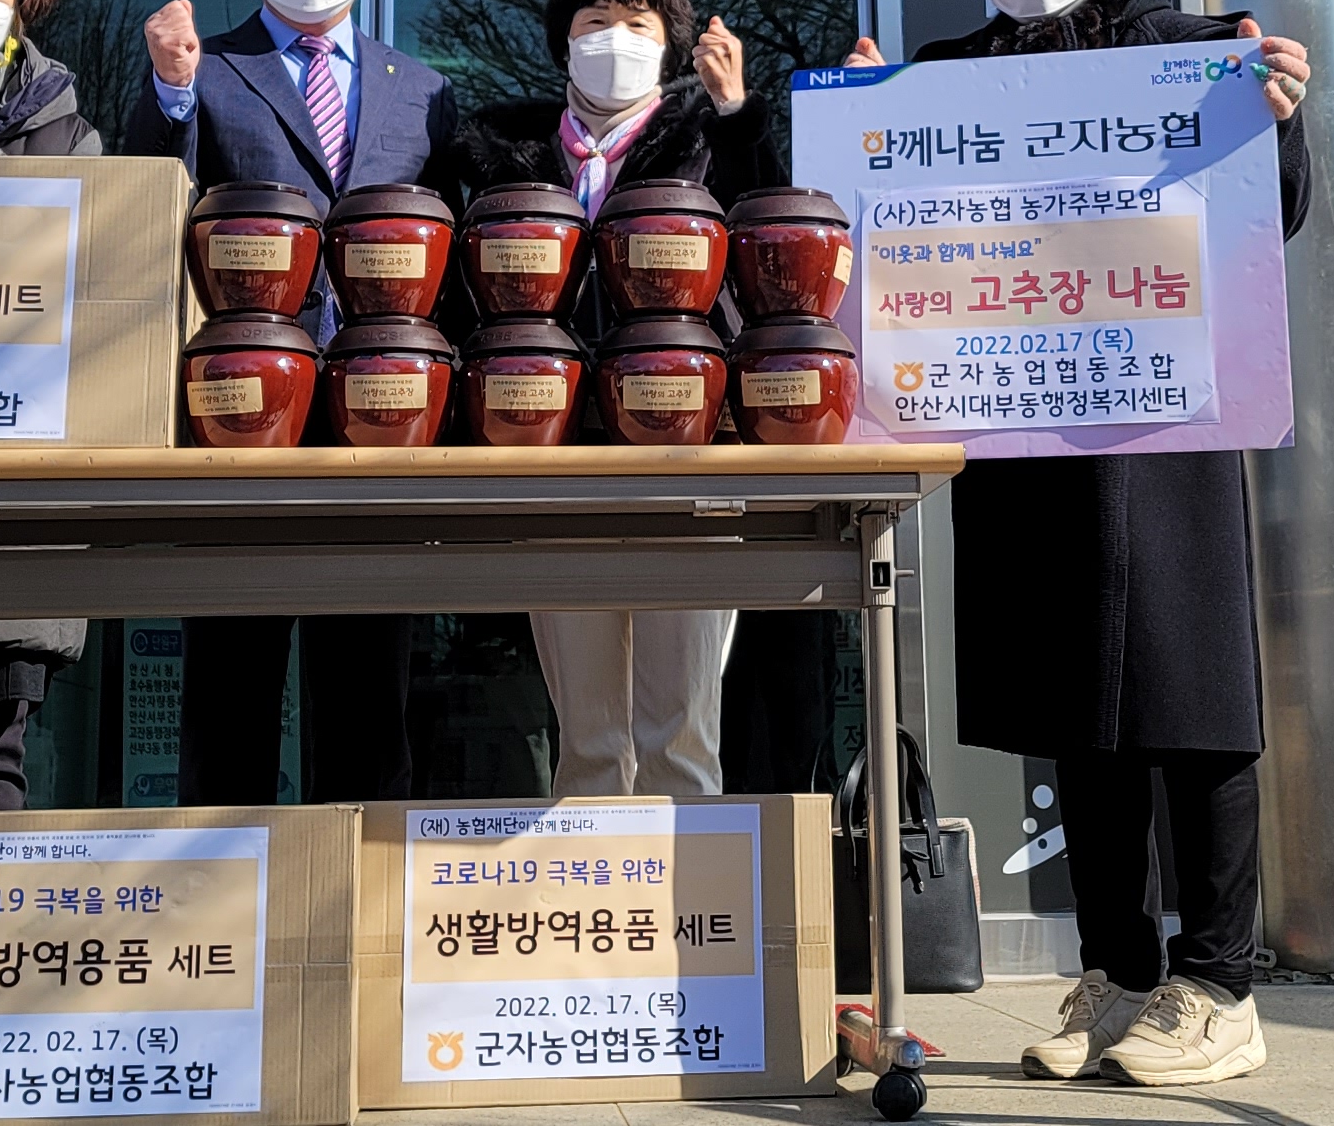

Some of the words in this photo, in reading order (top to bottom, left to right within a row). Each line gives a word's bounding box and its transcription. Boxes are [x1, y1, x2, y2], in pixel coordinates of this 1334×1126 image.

[1162, 58, 1202, 72] 함께하는
[809, 70, 845, 86] NH
[1023, 110, 1202, 158] 군자농협
[872, 194, 1011, 229] (사)군자농협
[1019, 187, 1163, 221] 농가주부모임
[224, 248, 248, 259] 사랑의
[250, 248, 276, 259] 고추장
[360, 257, 384, 267] 사랑의
[386, 257, 412, 268] 고추장
[495, 252, 519, 262] 사랑의
[522, 252, 547, 262] 고추장
[646, 248, 671, 258] 사랑의
[673, 248, 697, 258] 고추장
[937, 242, 974, 262] 함께
[878, 290, 953, 318] 사랑의
[966, 268, 1091, 316] 고추장
[1106, 264, 1191, 310] 나눔
[955, 331, 1083, 357] 2022.02.17
[1092, 327, 1134, 355] (목)
[198, 394, 220, 405] 사랑의
[221, 391, 247, 403] 고추장
[361, 387, 387, 397] 사랑의
[388, 387, 414, 397] 고추장
[502, 388, 527, 398] 사랑의
[529, 388, 554, 398] 고추장
[640, 389, 665, 399] 사랑의
[667, 389, 692, 399] 고추장
[755, 386, 779, 396] 사랑의
[781, 384, 806, 395] 고추장
[894, 387, 1188, 423] 안산시대부동행정복지센터
[420, 817, 450, 837] (재)
[455, 815, 530, 835] 농협재단이
[532, 818, 558, 834] 함께
[560, 818, 599, 833] 합니다.
[21, 844, 48, 860] 함께
[50, 844, 92, 860] 합니다.
[431, 859, 538, 886] 코로나19
[546, 859, 613, 888] 극복을
[620, 857, 667, 885] 위한
[33, 886, 106, 916] 극복을
[113, 885, 164, 914] 위한
[424, 907, 660, 957] 생활방역용품
[673, 912, 737, 948] 세트
[166, 943, 237, 980] 세트
[494, 997, 558, 1018] 2022.
[564, 995, 599, 1017] 02.
[605, 995, 640, 1016] 17.
[647, 991, 688, 1019] (목)
[46, 1030, 84, 1054] 02.
[91, 1029, 128, 1054] 17.
[136, 1026, 179, 1055] (목)
[474, 1023, 725, 1067] 군자농업협동조합
